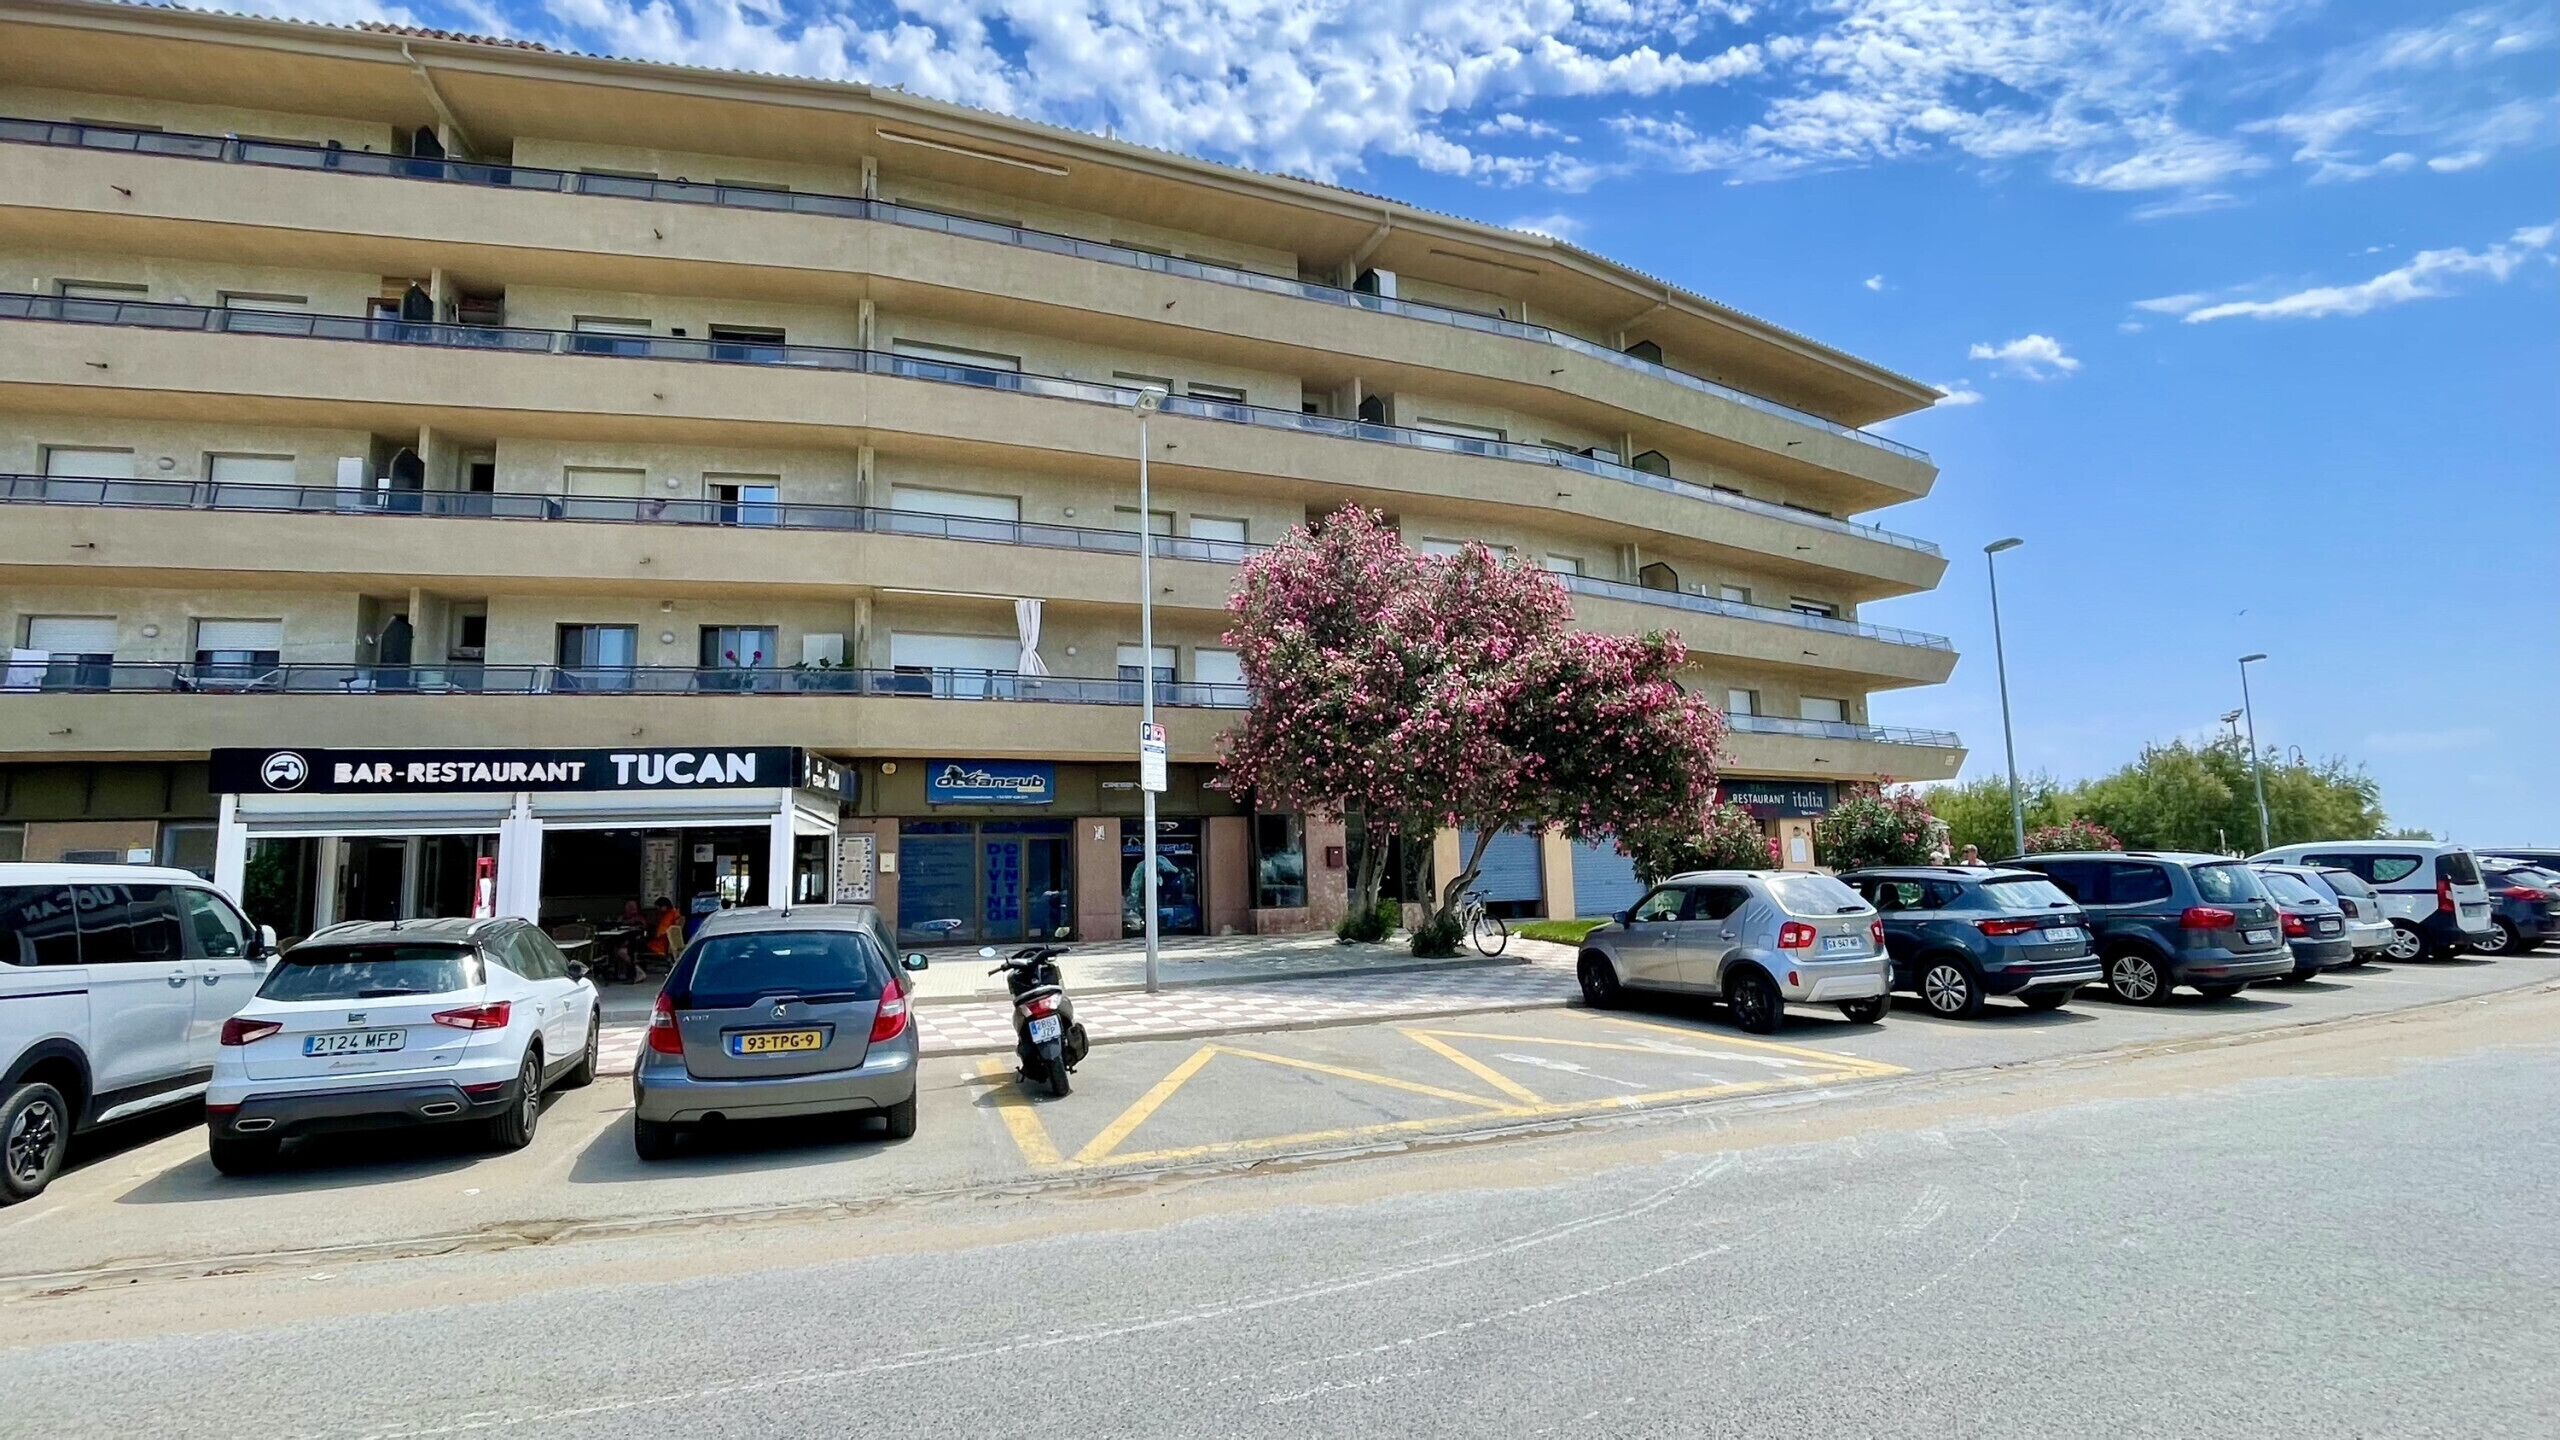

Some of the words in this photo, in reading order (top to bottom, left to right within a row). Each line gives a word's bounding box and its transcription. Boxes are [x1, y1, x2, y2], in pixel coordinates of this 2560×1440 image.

[334, 762, 585, 783] BAR-RESTAURANT
[610, 753, 756, 785] TUCAN
[1732, 793, 1785, 805] RESTAURANT
[1792, 791, 1824, 808] italia
[315, 1035, 358, 1051] 2124
[365, 1032, 399, 1047] MFP
[747, 1034, 814, 1050] 93-TPG-9
